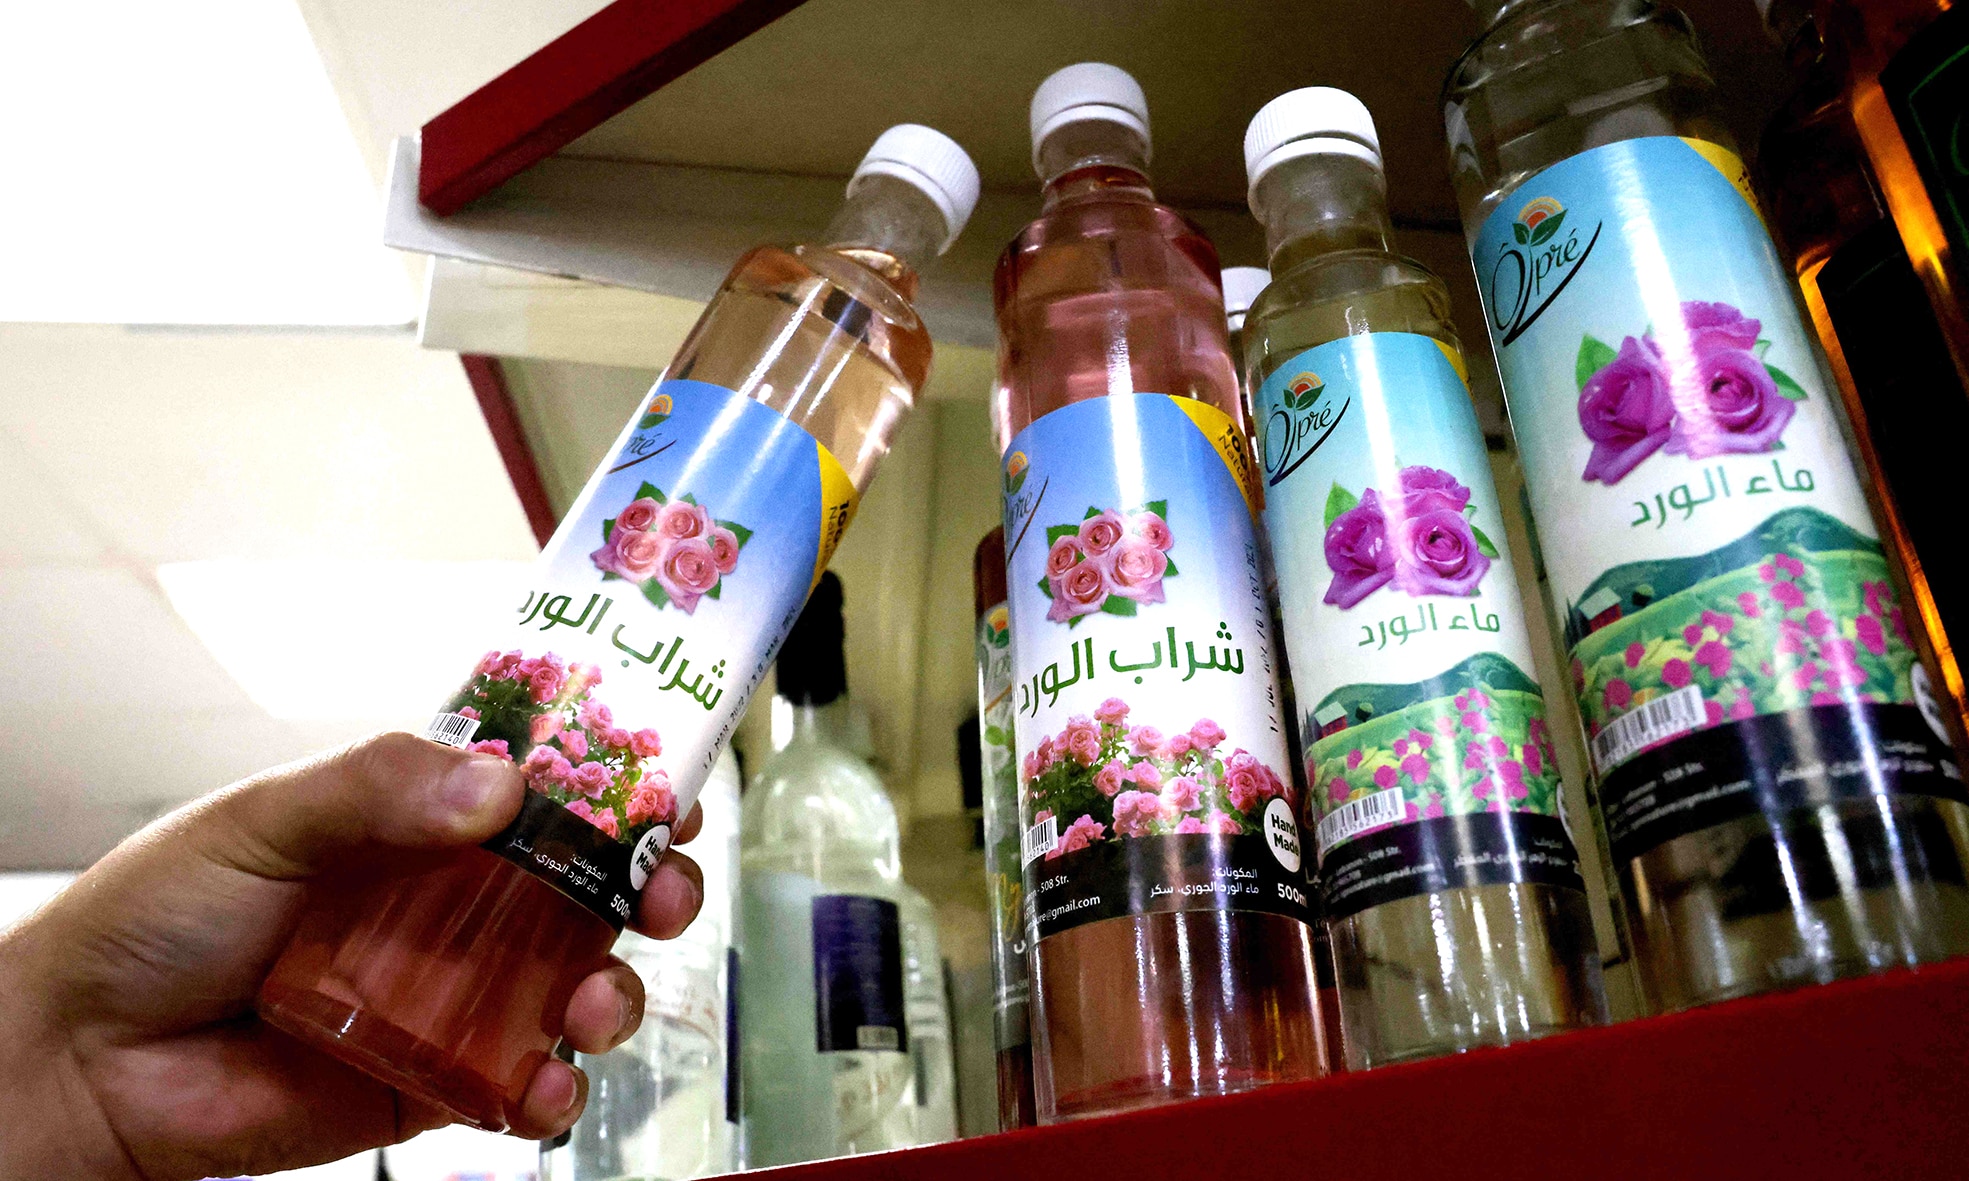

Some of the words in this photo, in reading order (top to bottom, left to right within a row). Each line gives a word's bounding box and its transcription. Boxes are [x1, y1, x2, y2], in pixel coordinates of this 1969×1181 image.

[1226, 423, 1249, 473] 100
[1744, 458, 1815, 495] ماء
[1631, 465, 1730, 530] الورد
[517, 590, 614, 635] الورد
[1448, 602, 1500, 633] ماء
[1358, 602, 1438, 651] الورد
[1109, 621, 1244, 685] شراب
[612, 624, 723, 710] شراب
[1020, 637, 1094, 718] الورد
[509, 838, 534, 853] سكر
[1273, 832, 1299, 857] Made
[570, 853, 608, 882] المكونات:
[635, 851, 655, 878] Mad
[1211, 866, 1258, 880] المكونات:
[568, 870, 589, 887] الورد
[587, 883, 599, 895] ماء
[1041, 878, 1054, 893] 508
[1054, 873, 1070, 886] Str.
[1150, 884, 1174, 900] سكر
[1220, 882, 1243, 895] الورد
[1245, 883, 1260, 894] ماء
[1277, 882, 1309, 908] 500m
